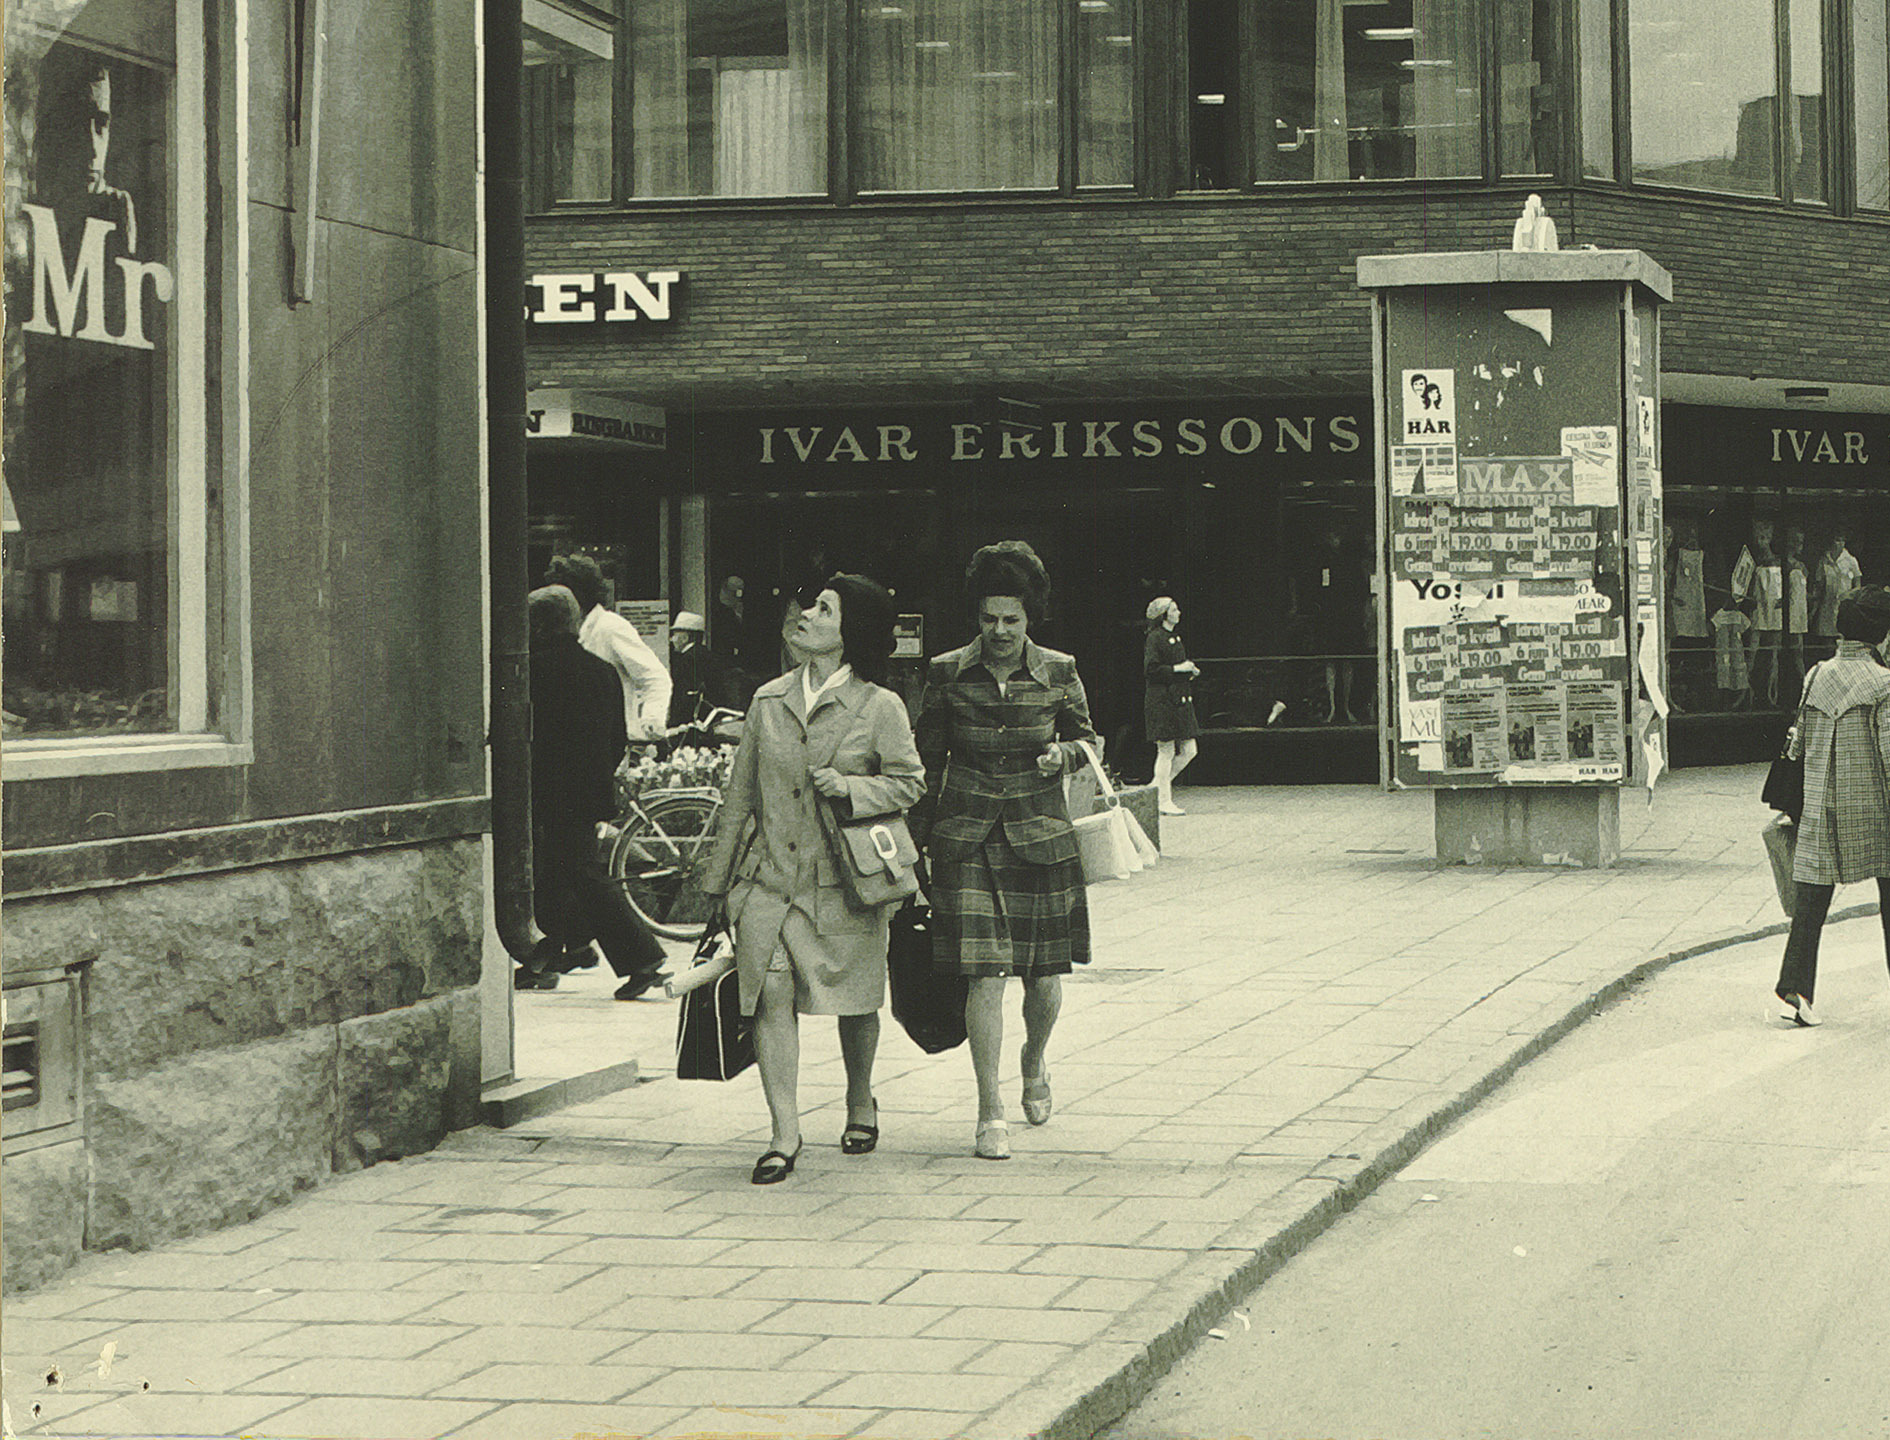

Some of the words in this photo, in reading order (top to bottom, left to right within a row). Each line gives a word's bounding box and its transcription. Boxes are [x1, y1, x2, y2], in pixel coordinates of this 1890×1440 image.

[21, 202, 174, 350] Mr
[525, 271, 680, 323] EN
[1407, 417, 1452, 435] HÅR
[759, 425, 918, 463] IVAR
[950, 416, 1361, 460] ERIKSSONS
[1770, 428, 1870, 465] IVAR
[1462, 463, 1571, 492] MAX
[1404, 537, 1412, 550] 6
[1415, 537, 1437, 552] juni
[1458, 536, 1492, 550] 19.00
[1505, 537, 1513, 550] 6
[1517, 537, 1538, 552] juni
[1558, 536, 1591, 550] 19.00
[1414, 658, 1422, 671] 6
[1426, 656, 1447, 673] juni
[1468, 651, 1501, 667] 19.00
[1516, 647, 1524, 659] 6
[1528, 646, 1549, 662] juni
[1570, 643, 1601, 658] 19.00
